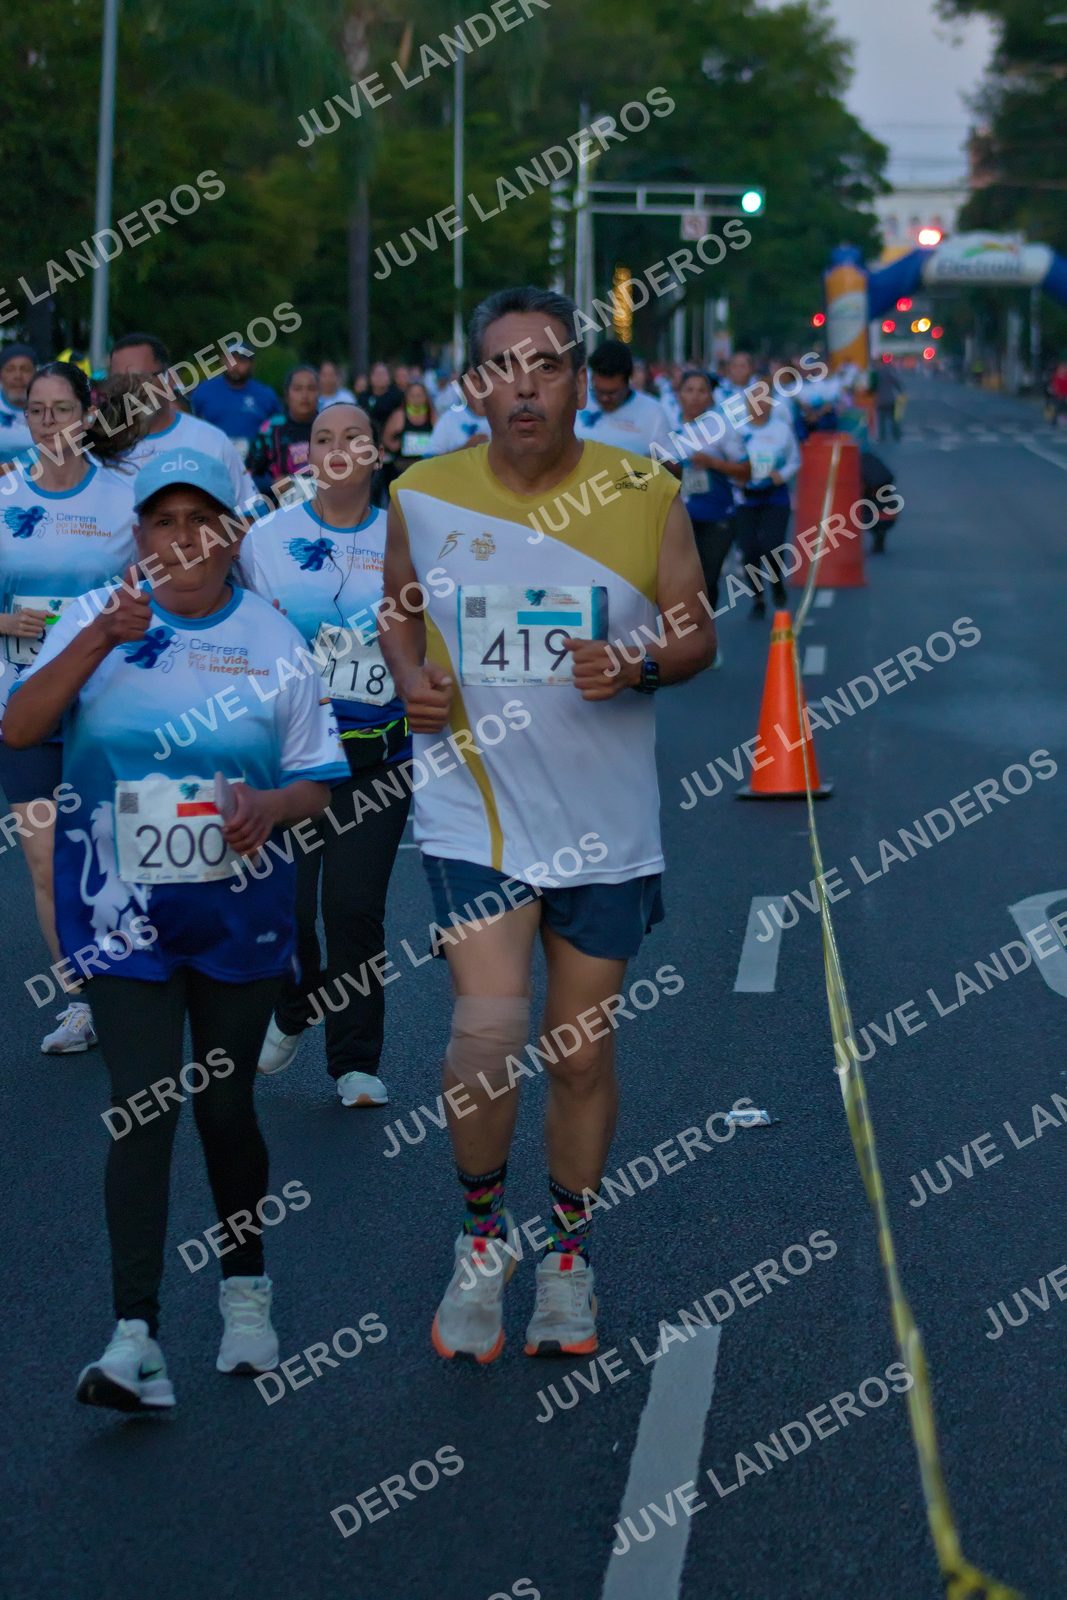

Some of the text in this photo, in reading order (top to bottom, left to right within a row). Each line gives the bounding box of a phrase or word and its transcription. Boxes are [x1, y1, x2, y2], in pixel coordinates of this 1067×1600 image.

[161, 453, 199, 473] alo
[56, 512, 96, 523] Carrera
[189, 638, 248, 656] Carrera
[481, 628, 571, 671] 419
[222, 655, 249, 667] Vida
[328, 658, 386, 695] 118
[136, 823, 227, 868] 200
